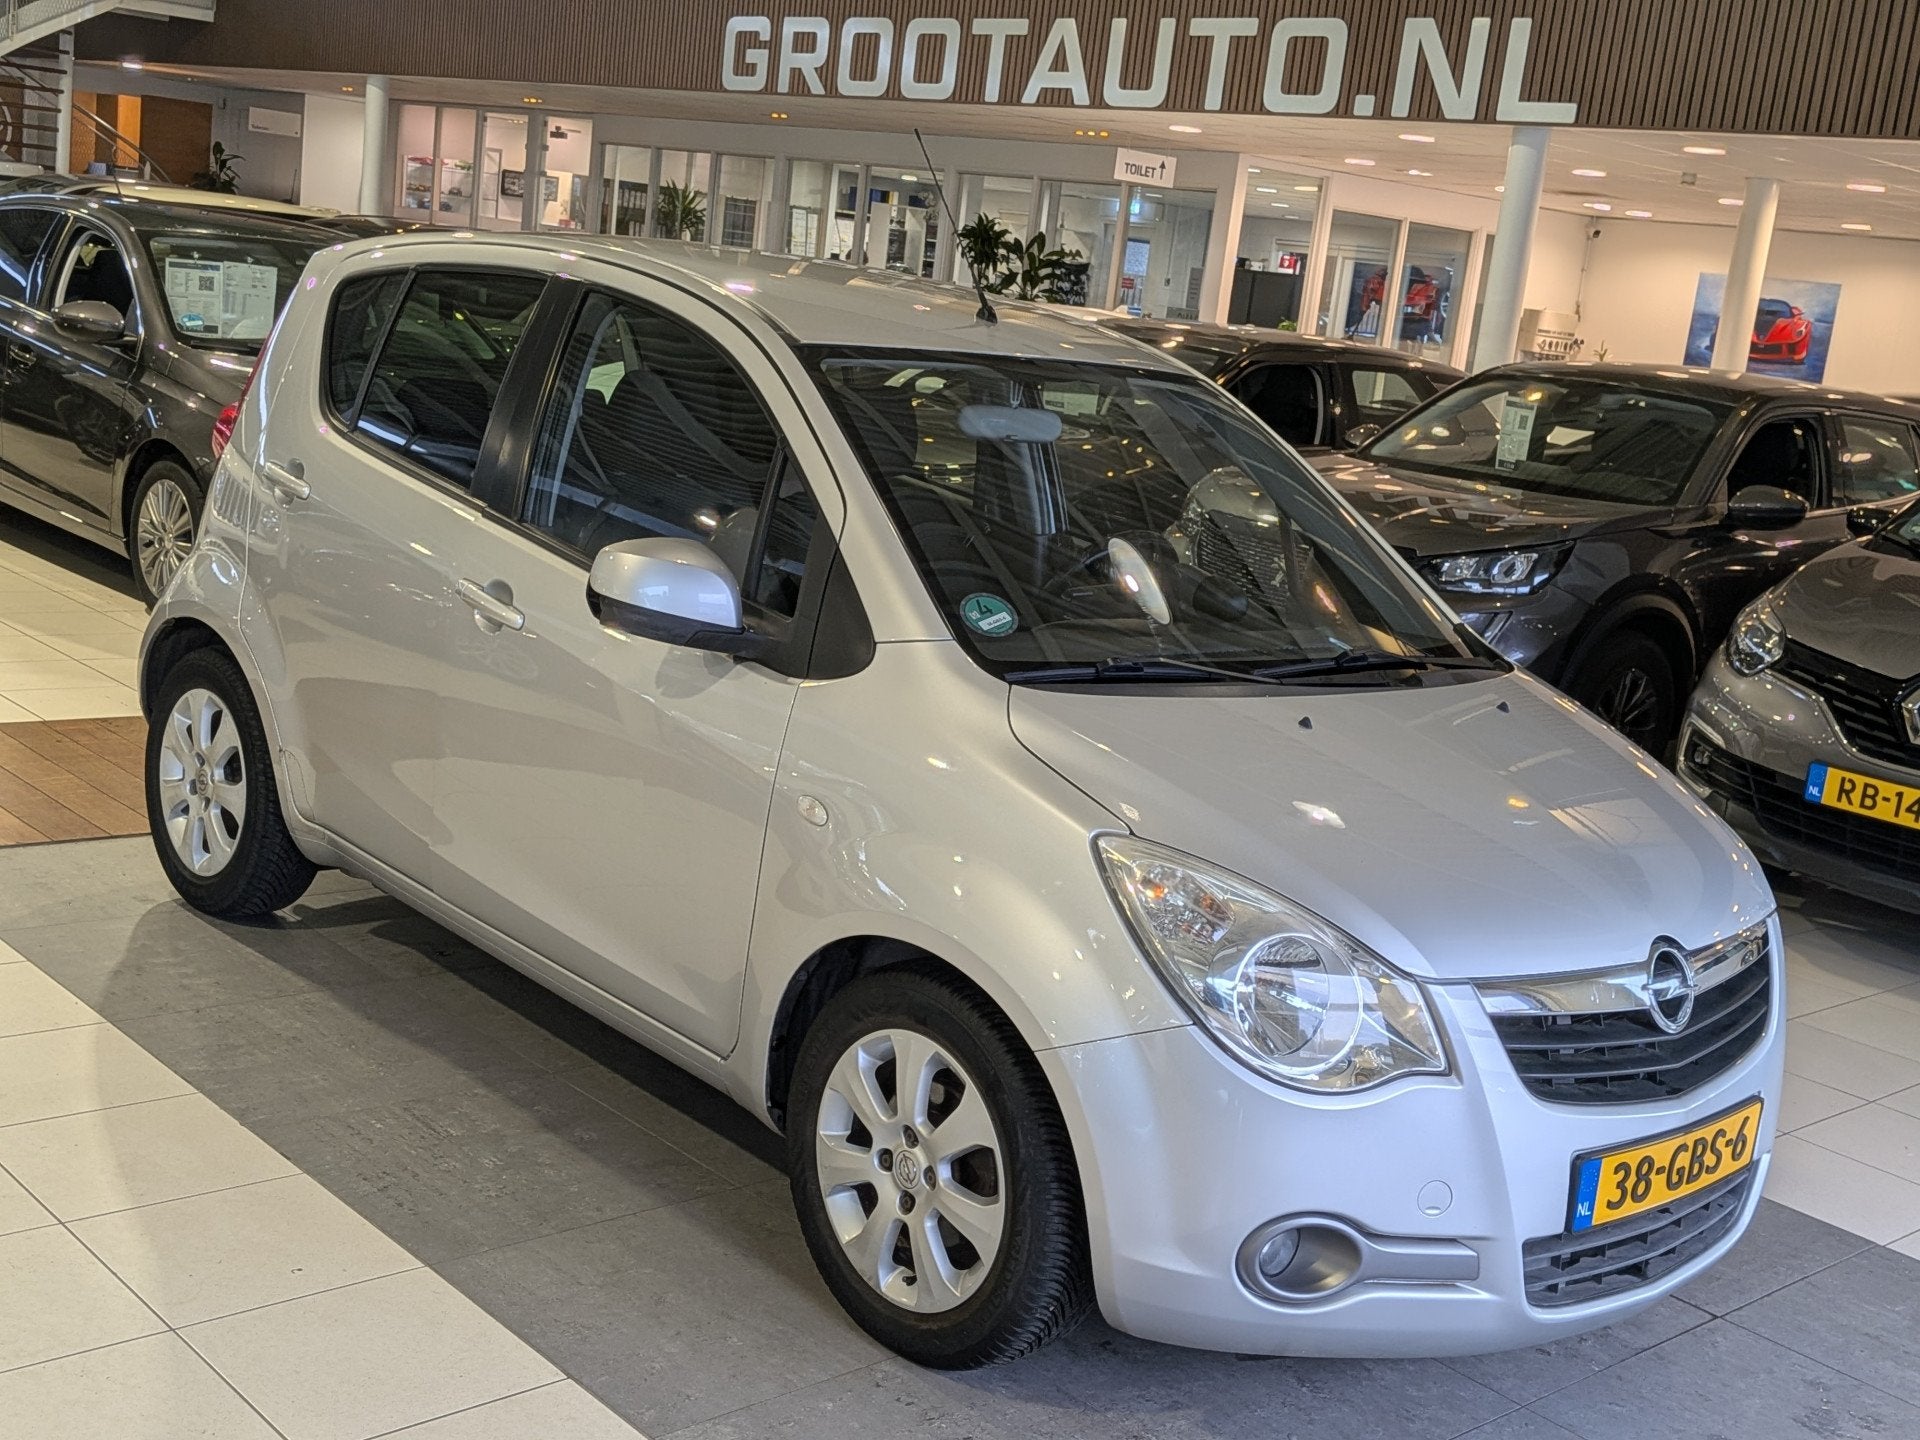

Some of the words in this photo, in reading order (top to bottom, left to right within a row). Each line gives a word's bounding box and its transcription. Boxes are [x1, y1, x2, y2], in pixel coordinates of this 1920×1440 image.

[722, 16, 1577, 123] GROOTAUTO.NL
[1124, 162, 1157, 179] TOILET
[976, 599, 993, 615] 4
[1808, 785, 1821, 797] NL
[1836, 776, 1920, 824] RB-14
[1606, 1116, 1751, 1210] 38-GBS-6
[1576, 1201, 1592, 1218] NL
